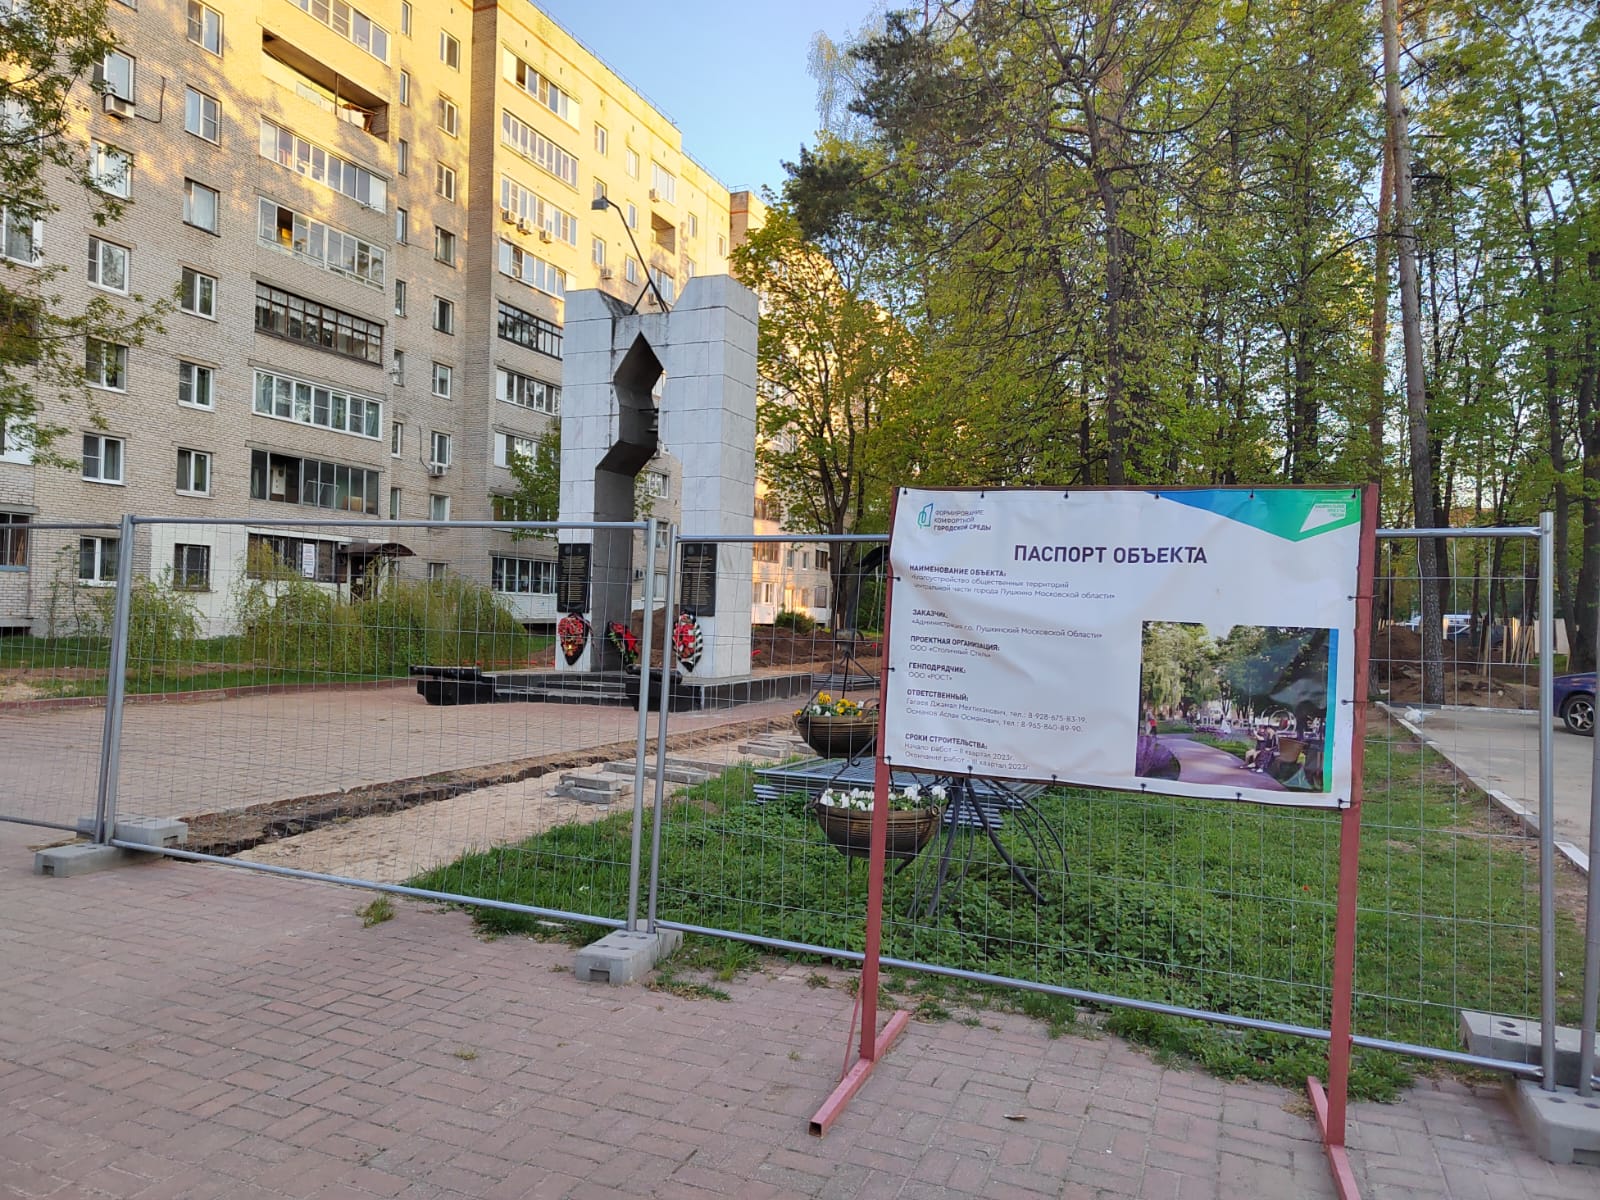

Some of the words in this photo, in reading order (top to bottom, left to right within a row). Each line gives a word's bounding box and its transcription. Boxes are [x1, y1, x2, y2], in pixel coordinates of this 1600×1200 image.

[934, 516, 975, 524] КОМФОРТНОЙ
[933, 524, 968, 532] ГОРОДСКОЙ
[1014, 545, 1107, 563] ПАСПОРТ
[1113, 546, 1208, 564] ОБЪЕКТА
[909, 564, 969, 576] НАИМЕНОВАНИЕ
[970, 568, 1007, 577] ОБЪЕКТА:
[1026, 581, 1069, 590] территорий
[973, 587, 999, 595] города
[1000, 588, 1033, 598] Пушкино
[1034, 590, 1080, 599] Московской
[976, 624, 1020, 634] Пушкинский
[1021, 627, 1065, 636] Московской
[1066, 629, 1103, 639] Области»
[909, 644, 927, 652] ООО
[910, 635, 951, 645] ПРОЕКТНАЯ
[952, 638, 1000, 651] ОРГАНИЗАЦИЯ:
[908, 662, 967, 674] ГЕНПОДРЯДЧИК:
[908, 671, 926, 679] ООО
[927, 673, 953, 681] «РОСТ»
[906, 688, 969, 702] ОТВЕТСТВЕННЫЙ:
[904, 733, 928, 741] СРОКИ
[929, 736, 988, 750] СТРОИТЕЛЬСТВА:
[904, 743, 929, 751] Начало
[930, 745, 952, 753] работ
